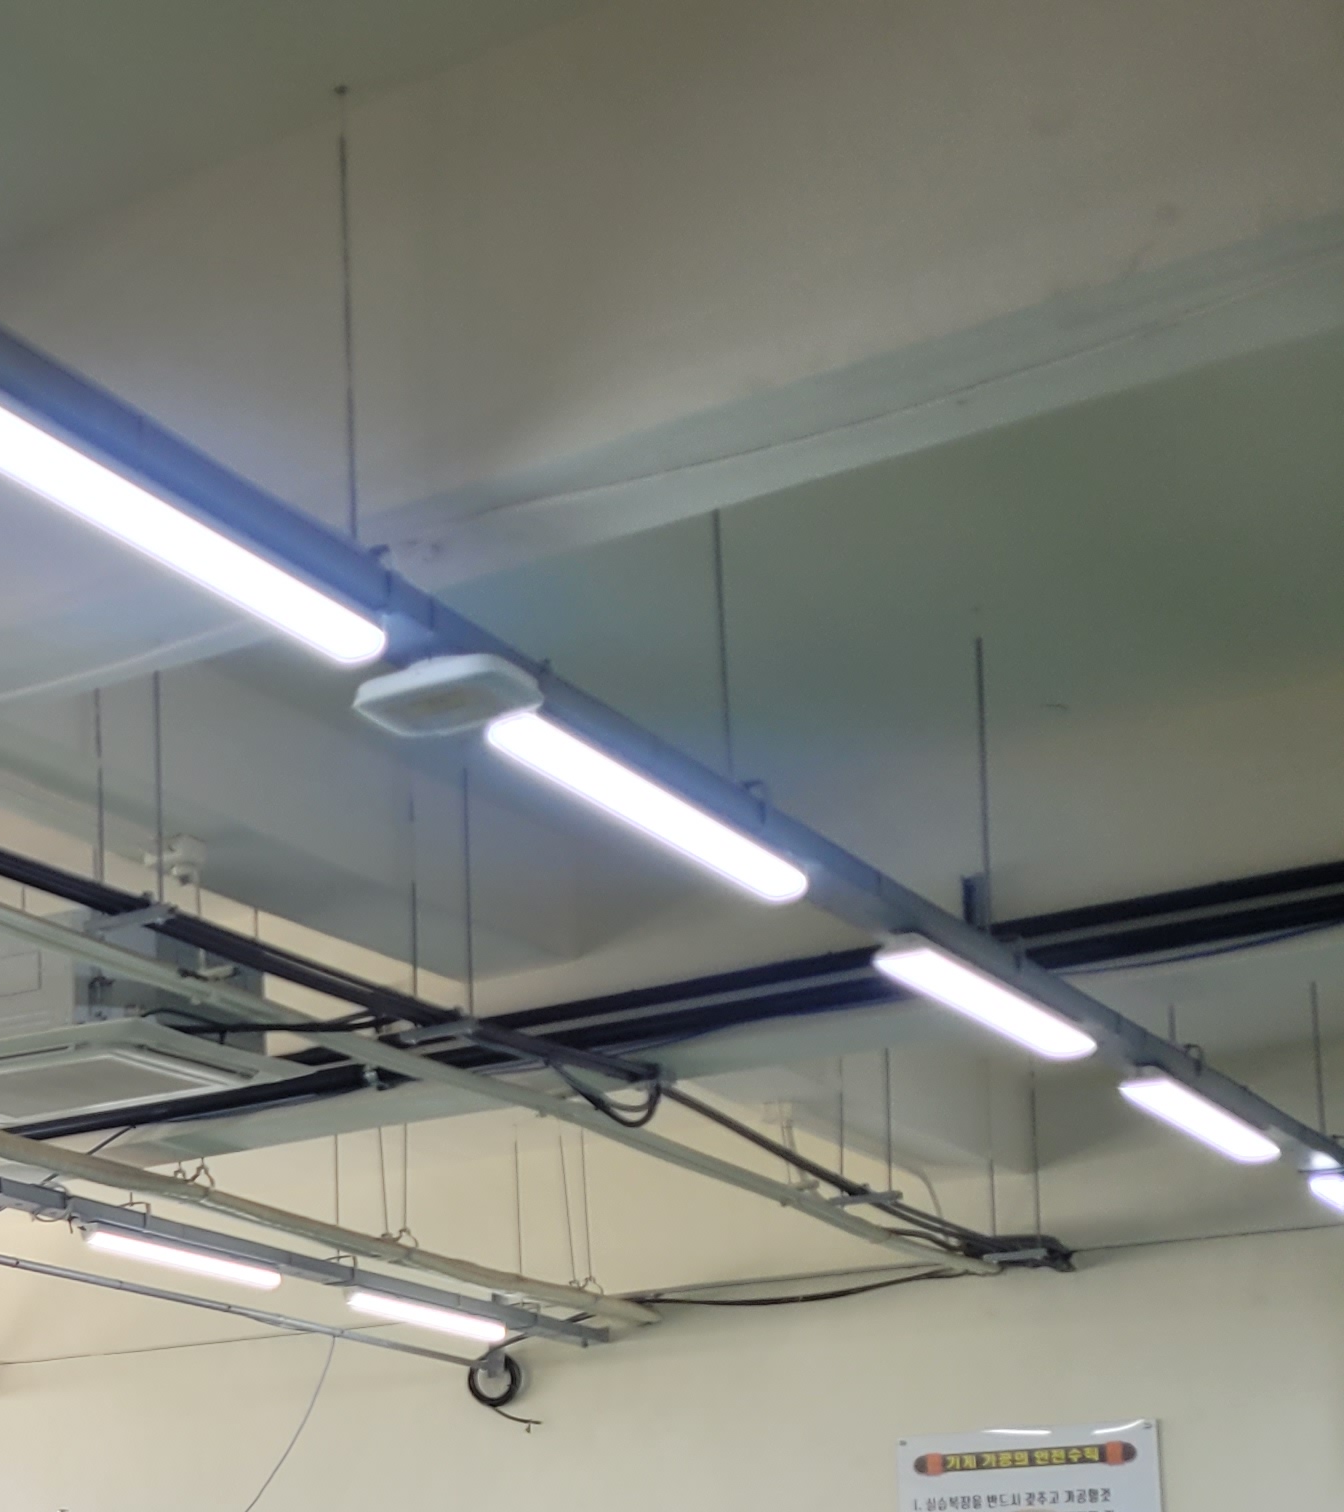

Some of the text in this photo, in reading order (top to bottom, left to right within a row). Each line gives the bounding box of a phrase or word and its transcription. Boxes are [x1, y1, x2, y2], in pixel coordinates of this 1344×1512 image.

[1034, 1447, 1100, 1466] 안전수칙
[927, 1495, 982, 1511] 실습복장을
[987, 1493, 1021, 1508] 반드시
[1025, 1491, 1059, 1506] 갖추고
